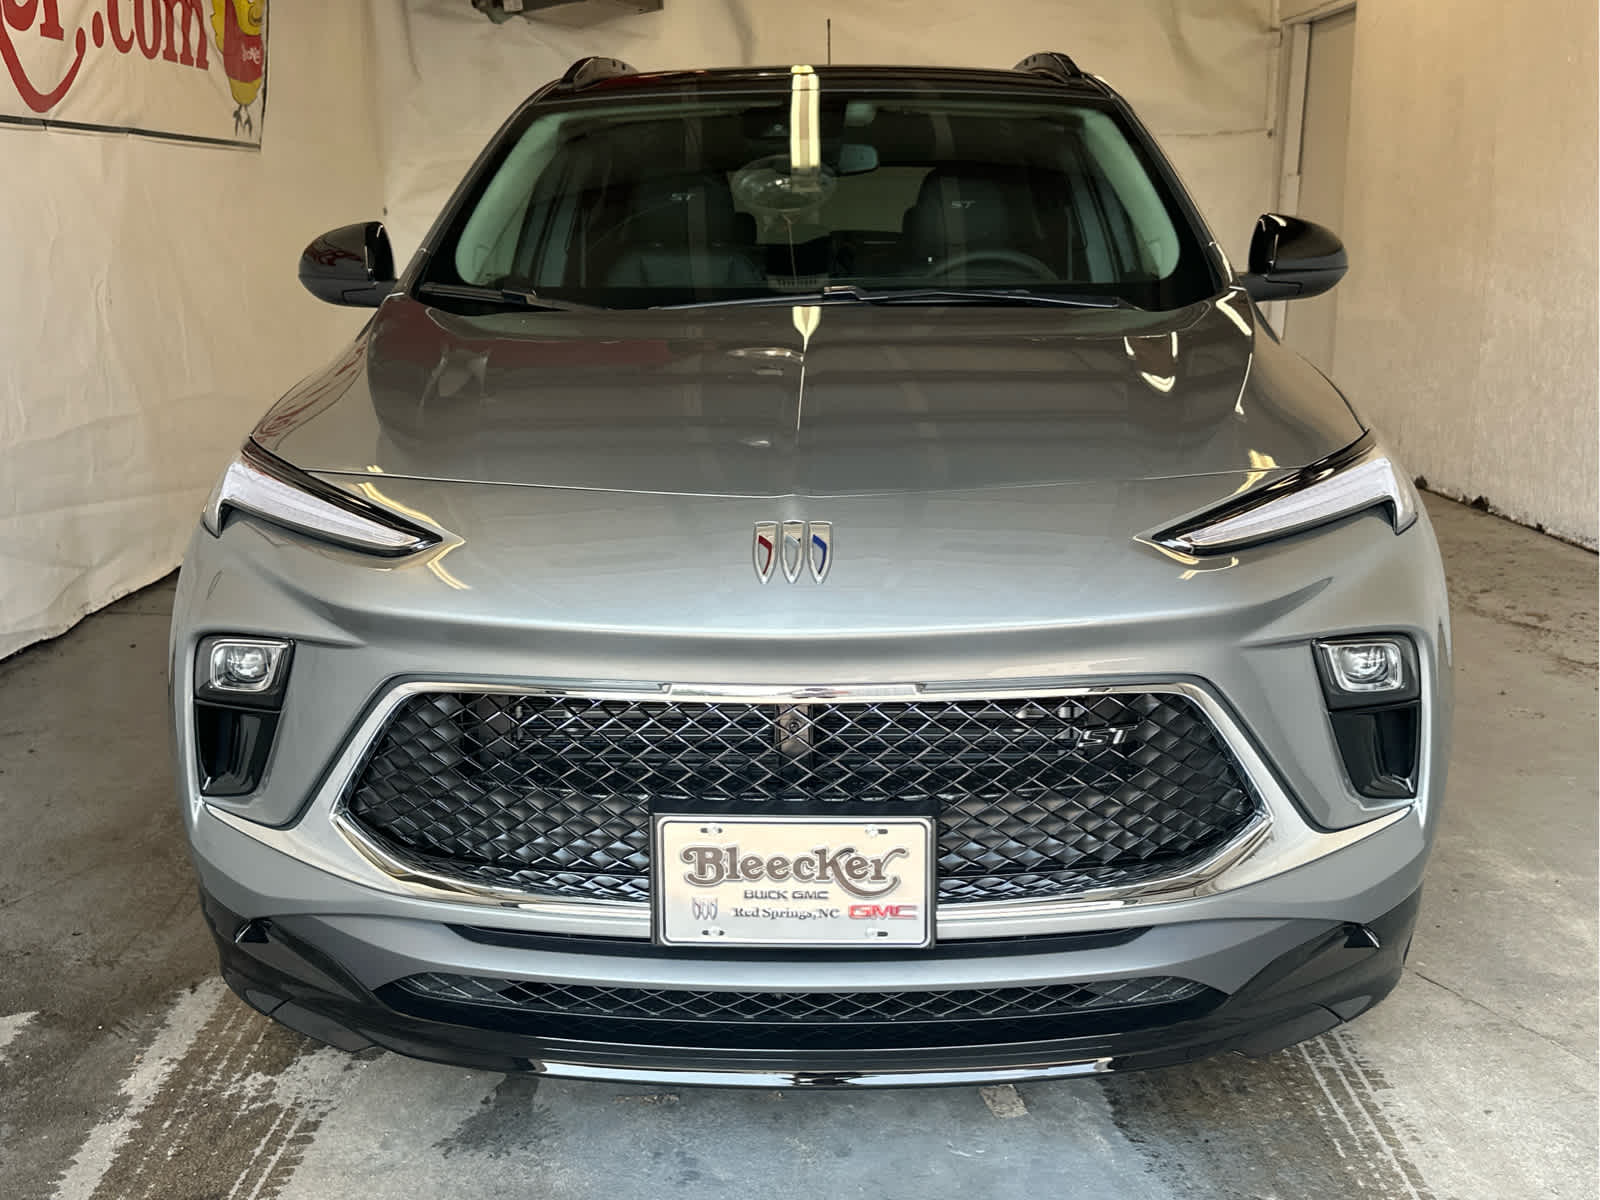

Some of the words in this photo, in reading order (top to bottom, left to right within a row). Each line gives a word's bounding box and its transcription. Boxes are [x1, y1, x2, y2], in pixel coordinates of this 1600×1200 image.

[1076, 724, 1138, 748] ST
[743, 889, 788, 900] BUICK
[791, 889, 830, 900] GMC
[733, 907, 760, 918] Red
[848, 904, 918, 920] GMC
